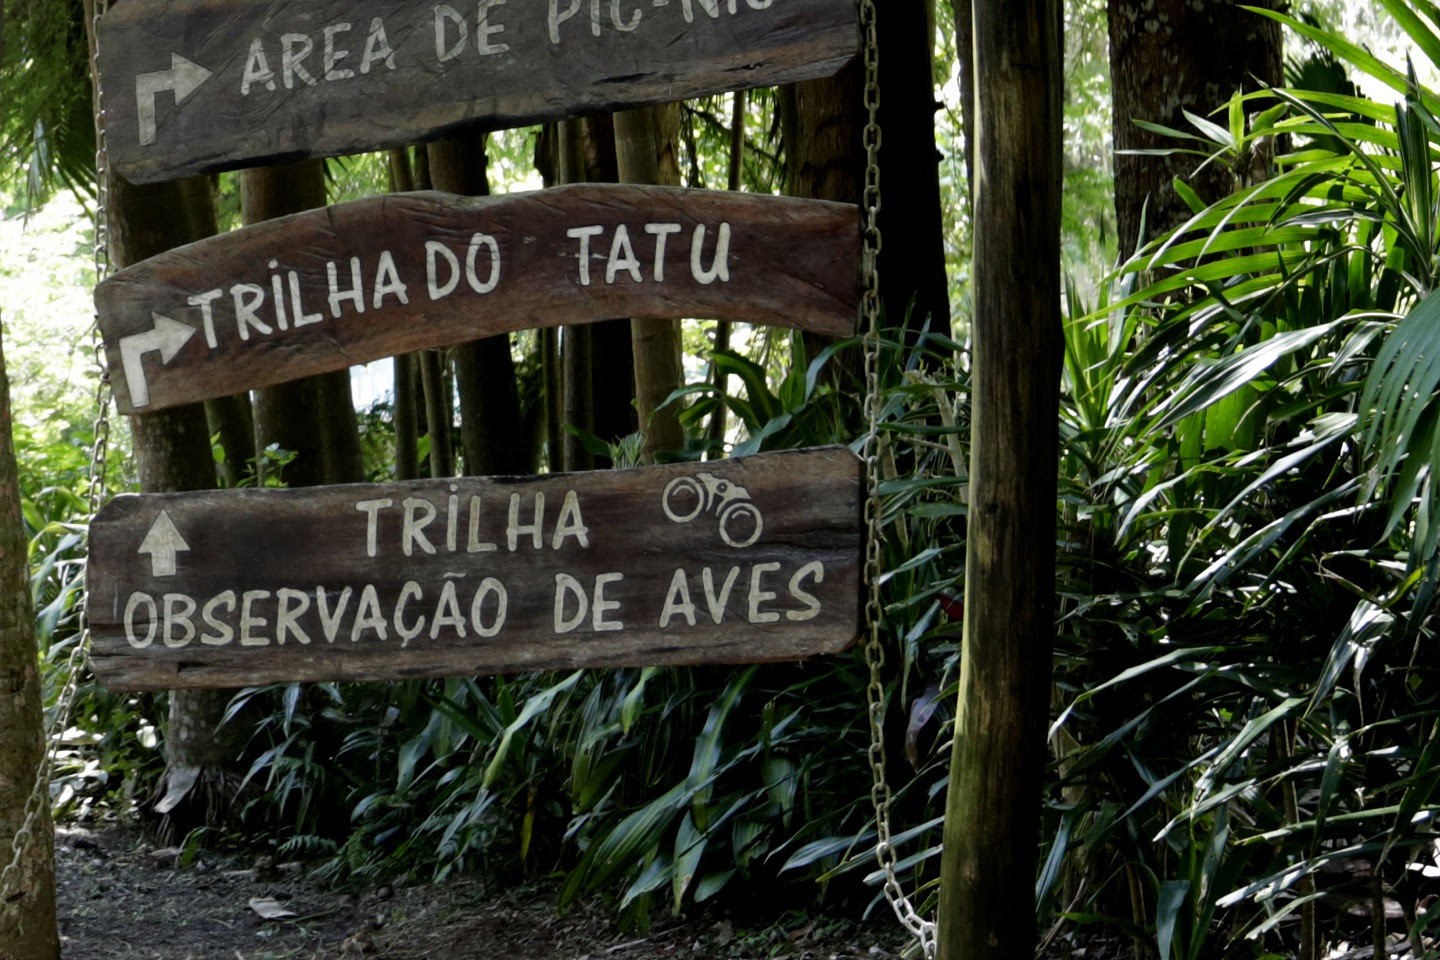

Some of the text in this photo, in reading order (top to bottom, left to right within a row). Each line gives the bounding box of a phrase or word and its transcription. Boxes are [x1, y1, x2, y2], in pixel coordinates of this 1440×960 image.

[240, 15, 396, 96] AREA
[187, 221, 731, 349] TRILHA DO TATU
[356, 483, 589, 557] TRILHA
[123, 560, 825, 650] OBSERVAÇÃO DE AVES
